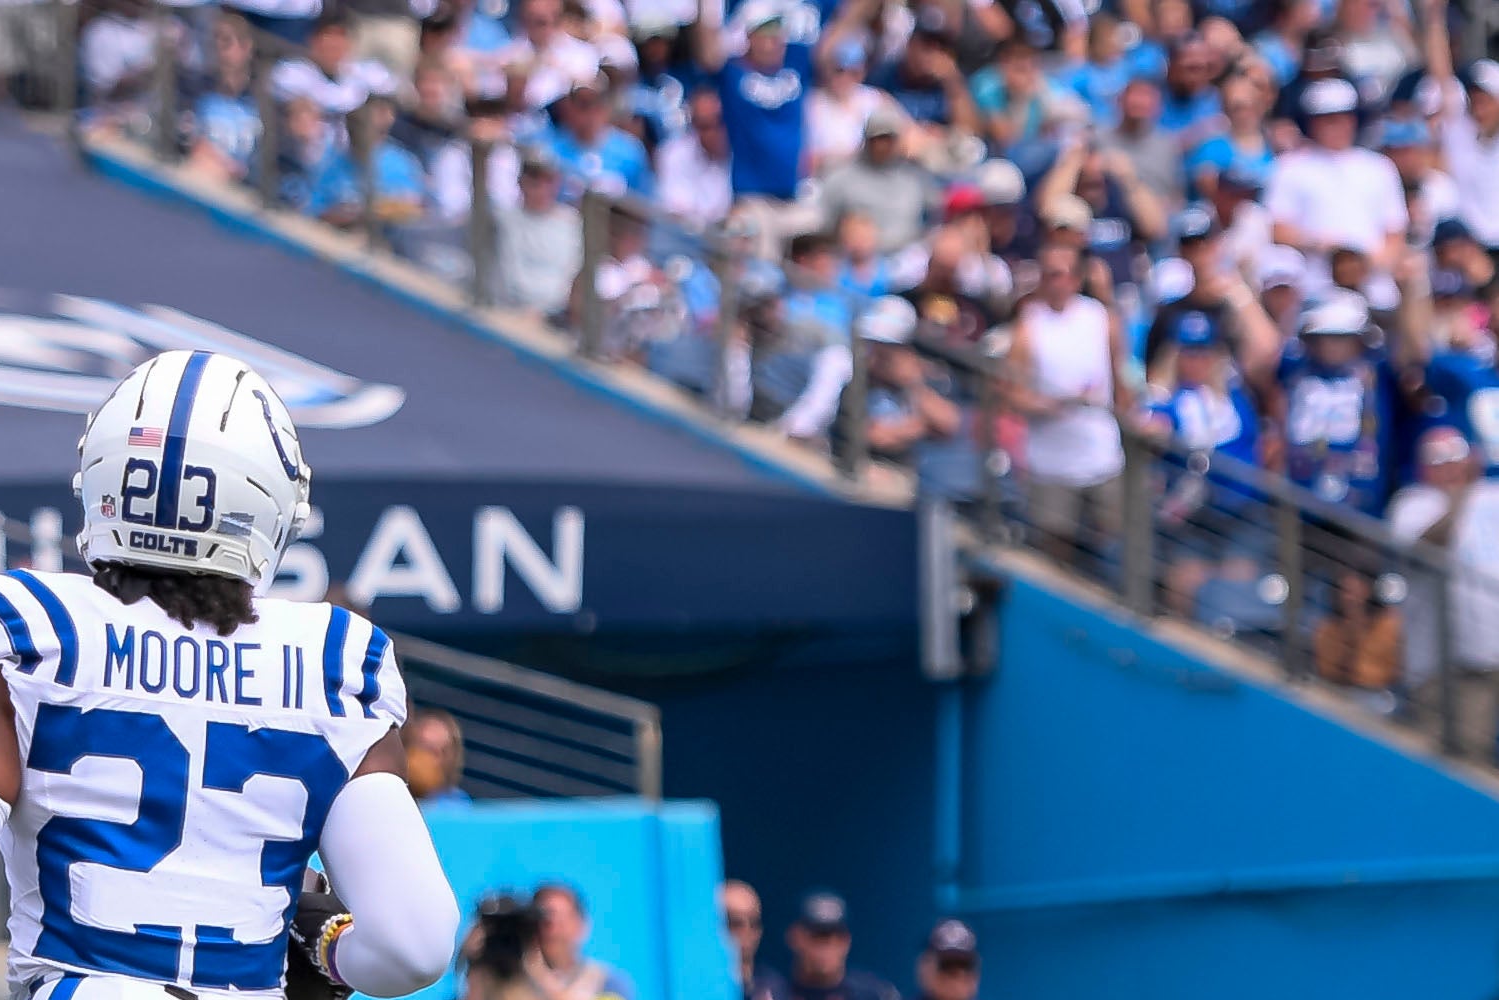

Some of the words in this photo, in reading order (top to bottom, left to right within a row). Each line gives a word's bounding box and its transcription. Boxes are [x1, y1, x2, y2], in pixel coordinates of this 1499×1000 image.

[121, 457, 217, 532] 23
[129, 531, 198, 557] COLTS
[104, 623, 263, 706] MOORE
[27, 702, 349, 991] 23
